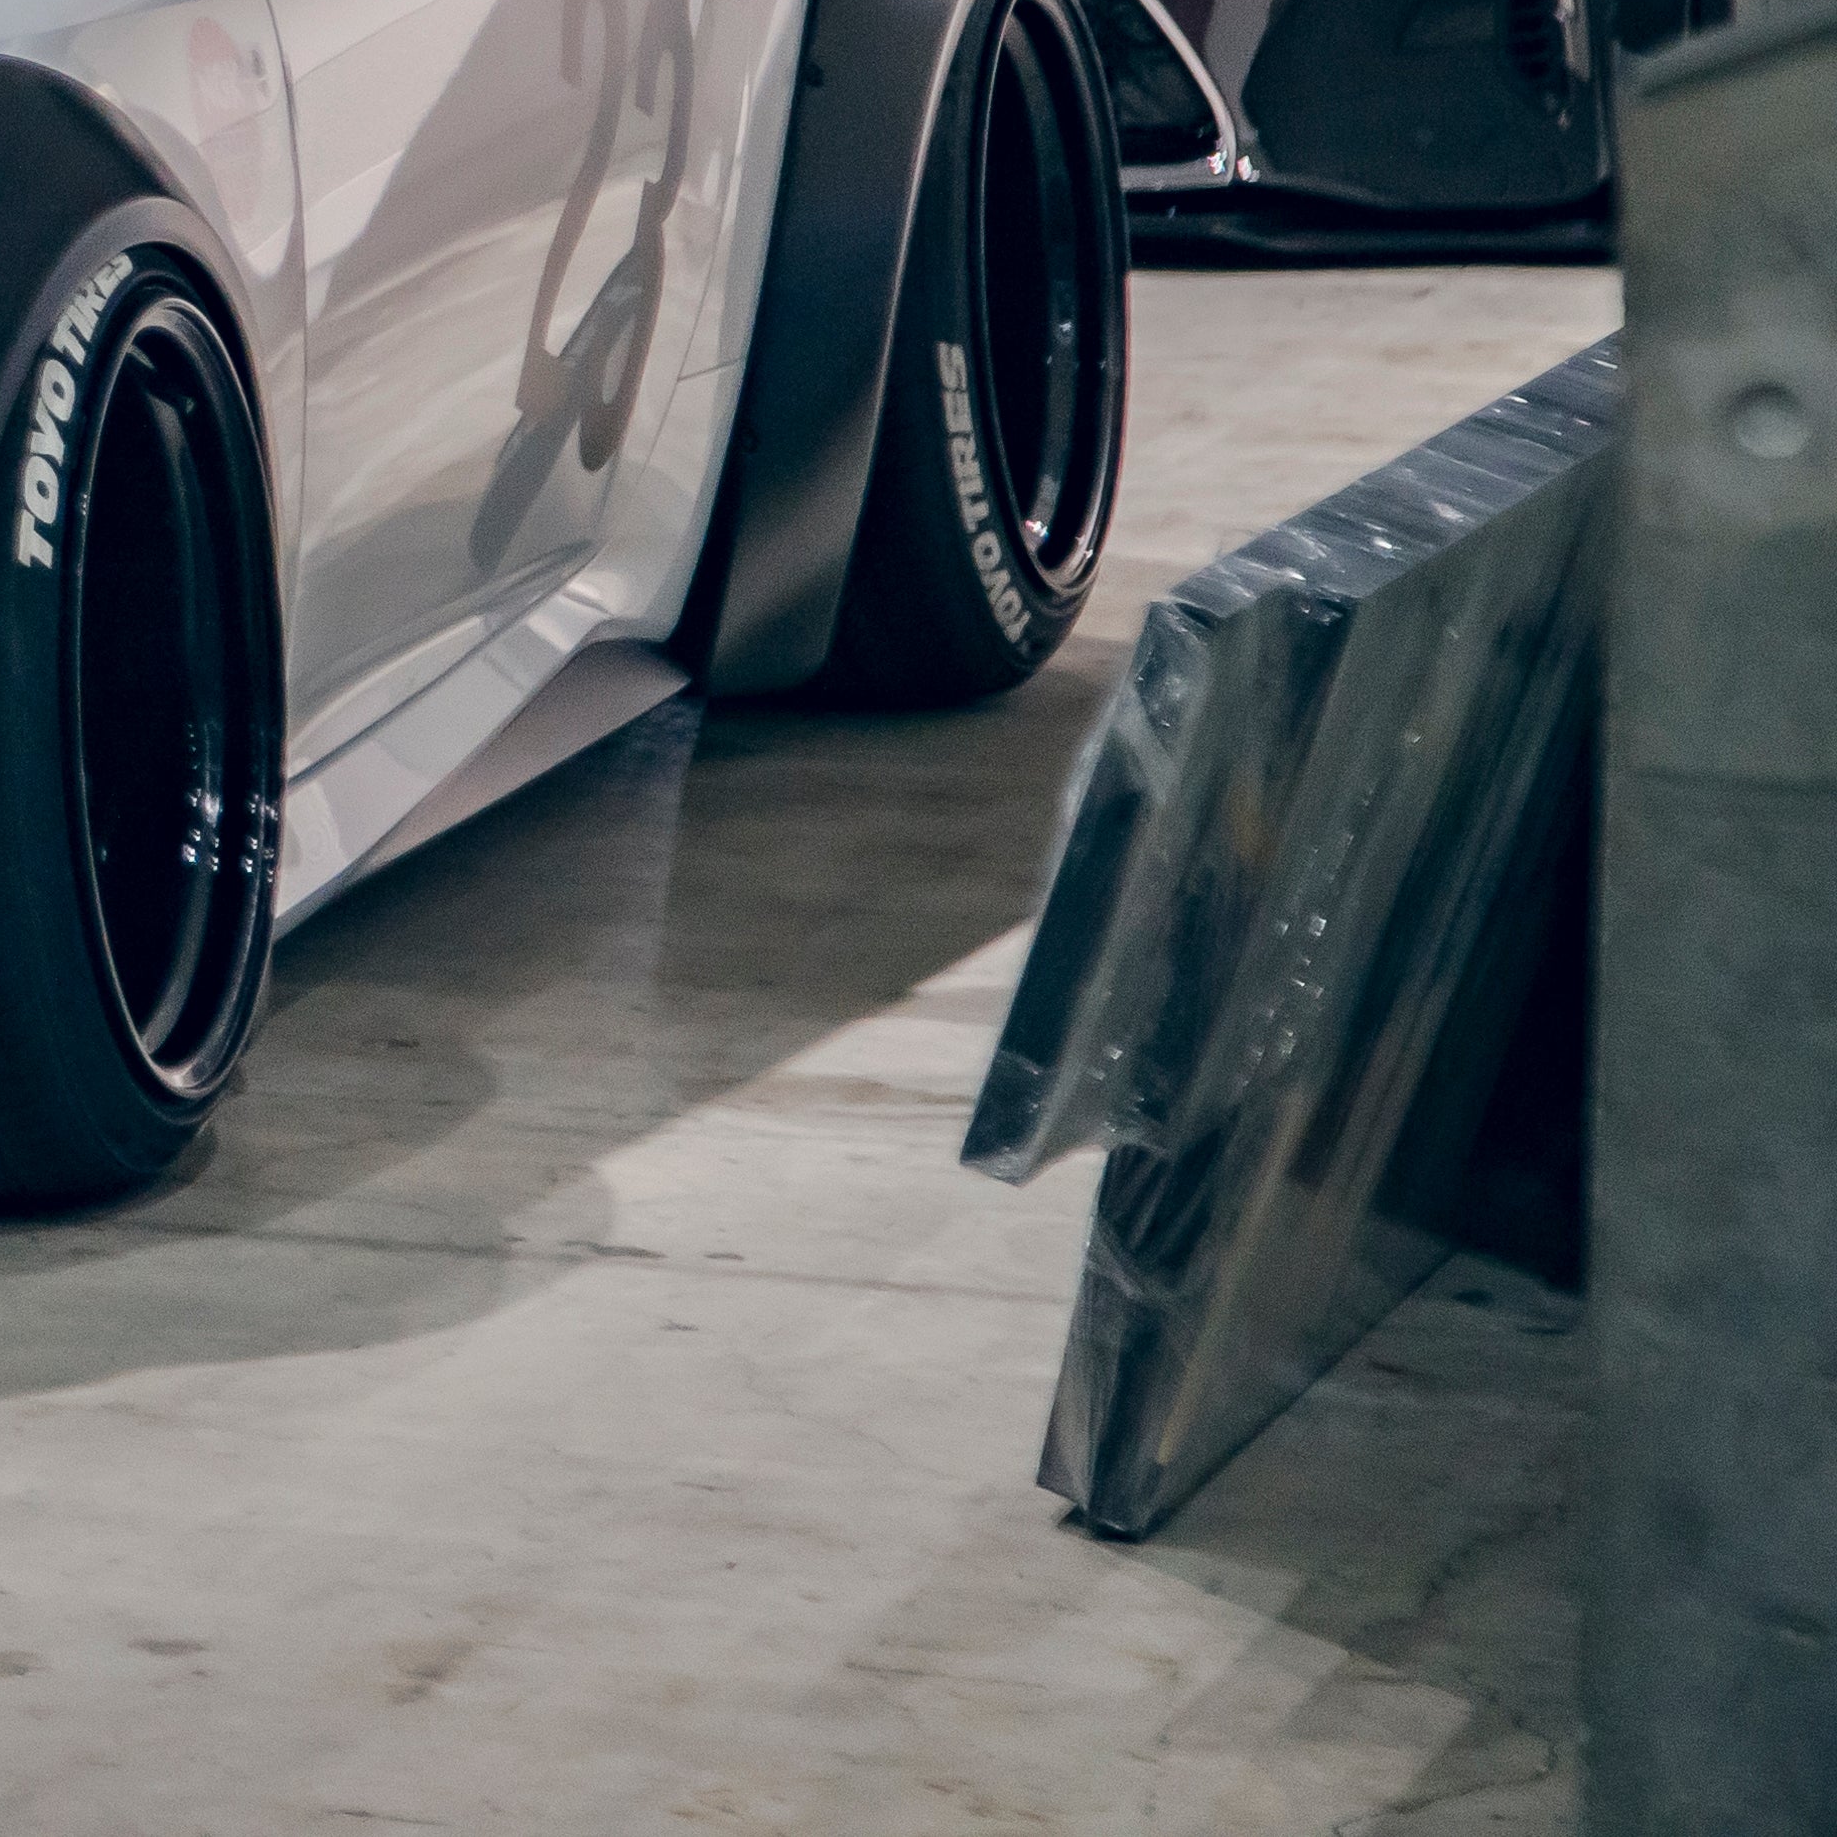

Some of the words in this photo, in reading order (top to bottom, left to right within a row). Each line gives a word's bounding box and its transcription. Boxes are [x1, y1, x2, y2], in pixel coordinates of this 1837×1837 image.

[18, 358, 76, 569] TOYO
[937, 341, 989, 534] TIRES
[971, 529, 1031, 644] TOYO
